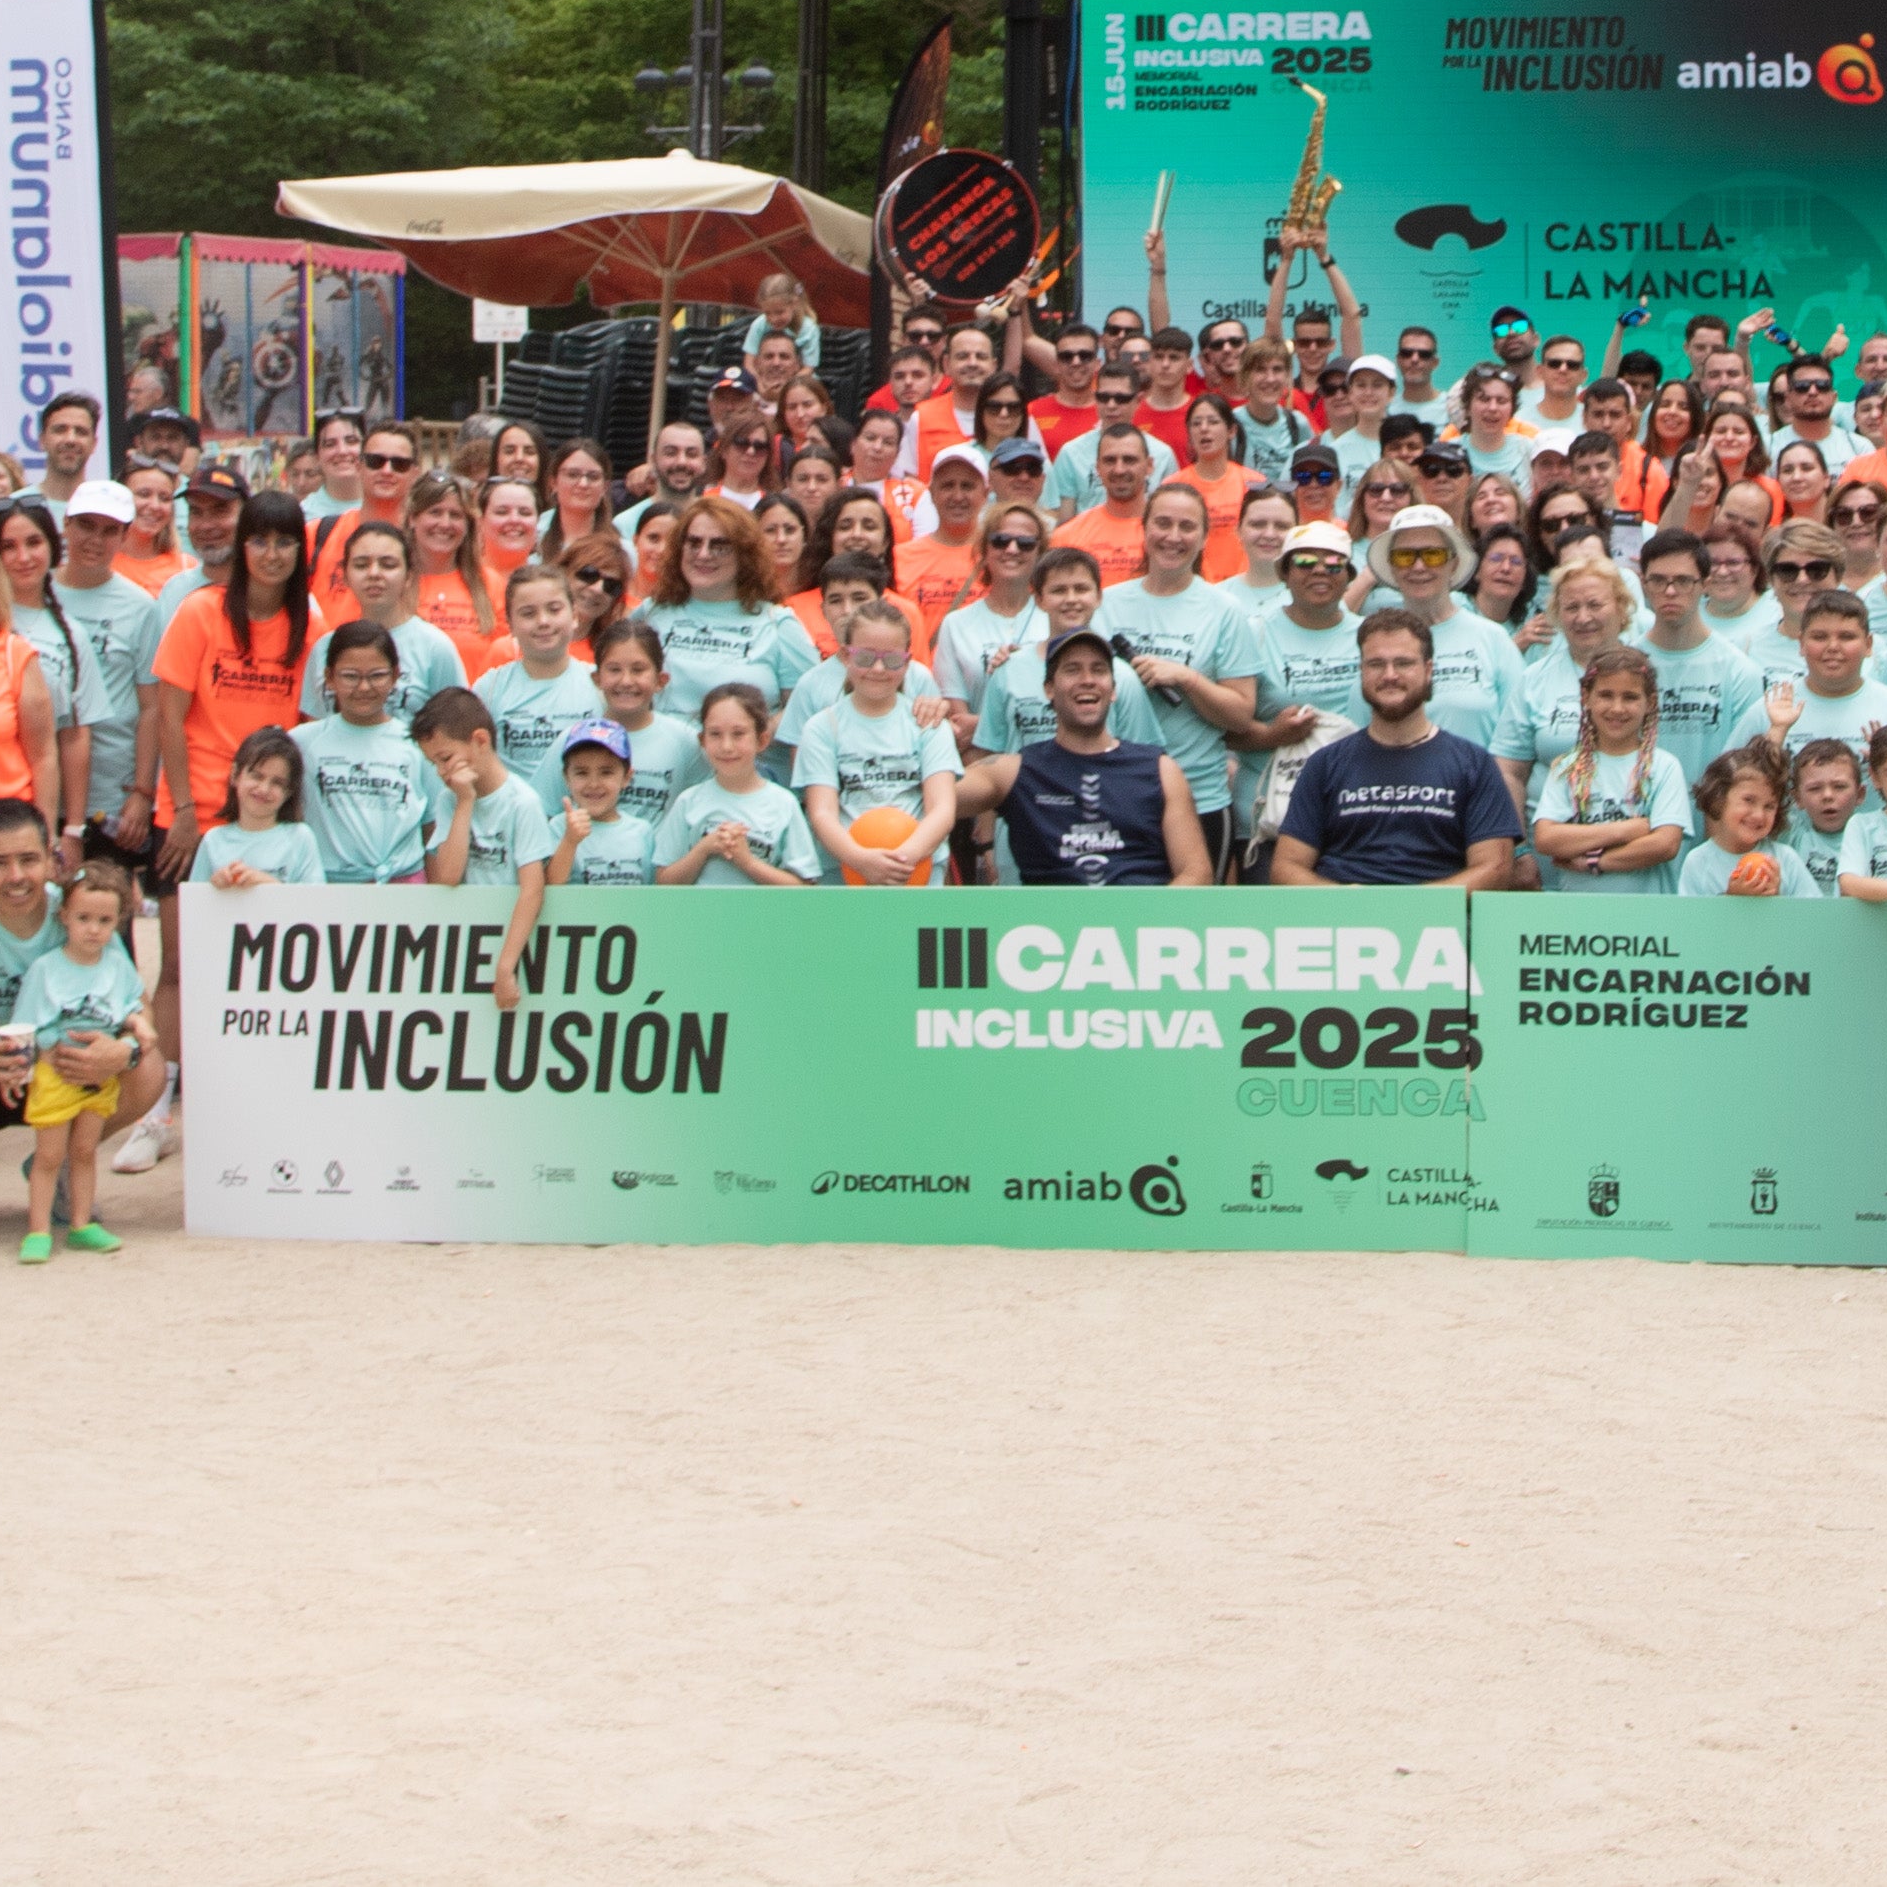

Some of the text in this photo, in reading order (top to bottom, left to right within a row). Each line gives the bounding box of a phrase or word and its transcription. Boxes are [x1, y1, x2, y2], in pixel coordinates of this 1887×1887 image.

[1167, 11, 1373, 42] CARRERA
[1444, 16, 1625, 49] MOVIMIENTO
[1134, 46, 1373, 74] INCLUSIVA 2025
[1442, 45, 1664, 92] POR LA INCLUSIÓN
[1676, 52, 1812, 90] amiab
[1134, 71, 1201, 82] MEMORIAL
[1134, 82, 1258, 97] ENCARNACIÓN
[1134, 98, 1231, 112] RODRÍGUEZ
[1545, 222, 1737, 253] CASTILLA-
[1545, 269, 1776, 300] LA MANCHA
[325, 774, 407, 791] CARRERA
[227, 923, 638, 996] MOVIMIENTO
[995, 924, 1484, 996] CARRERA
[1519, 934, 1681, 958] MEMORIAL
[1519, 965, 1811, 996] ENCARNACIÓN
[1519, 997, 1749, 1028] RODRÍGUEZ
[222, 990, 730, 1095] POR LA INCLUSIÓN
[916, 1006, 1484, 1072] INCLUSIVA 2025
[1236, 1077, 1487, 1122] CUENCA
[843, 1174, 971, 1194] DECATHLON
[1003, 1171, 1122, 1202] amiab
[1270, 1203, 1303, 1214] Mancha
[1387, 1190, 1500, 1213] LA MANCHA
